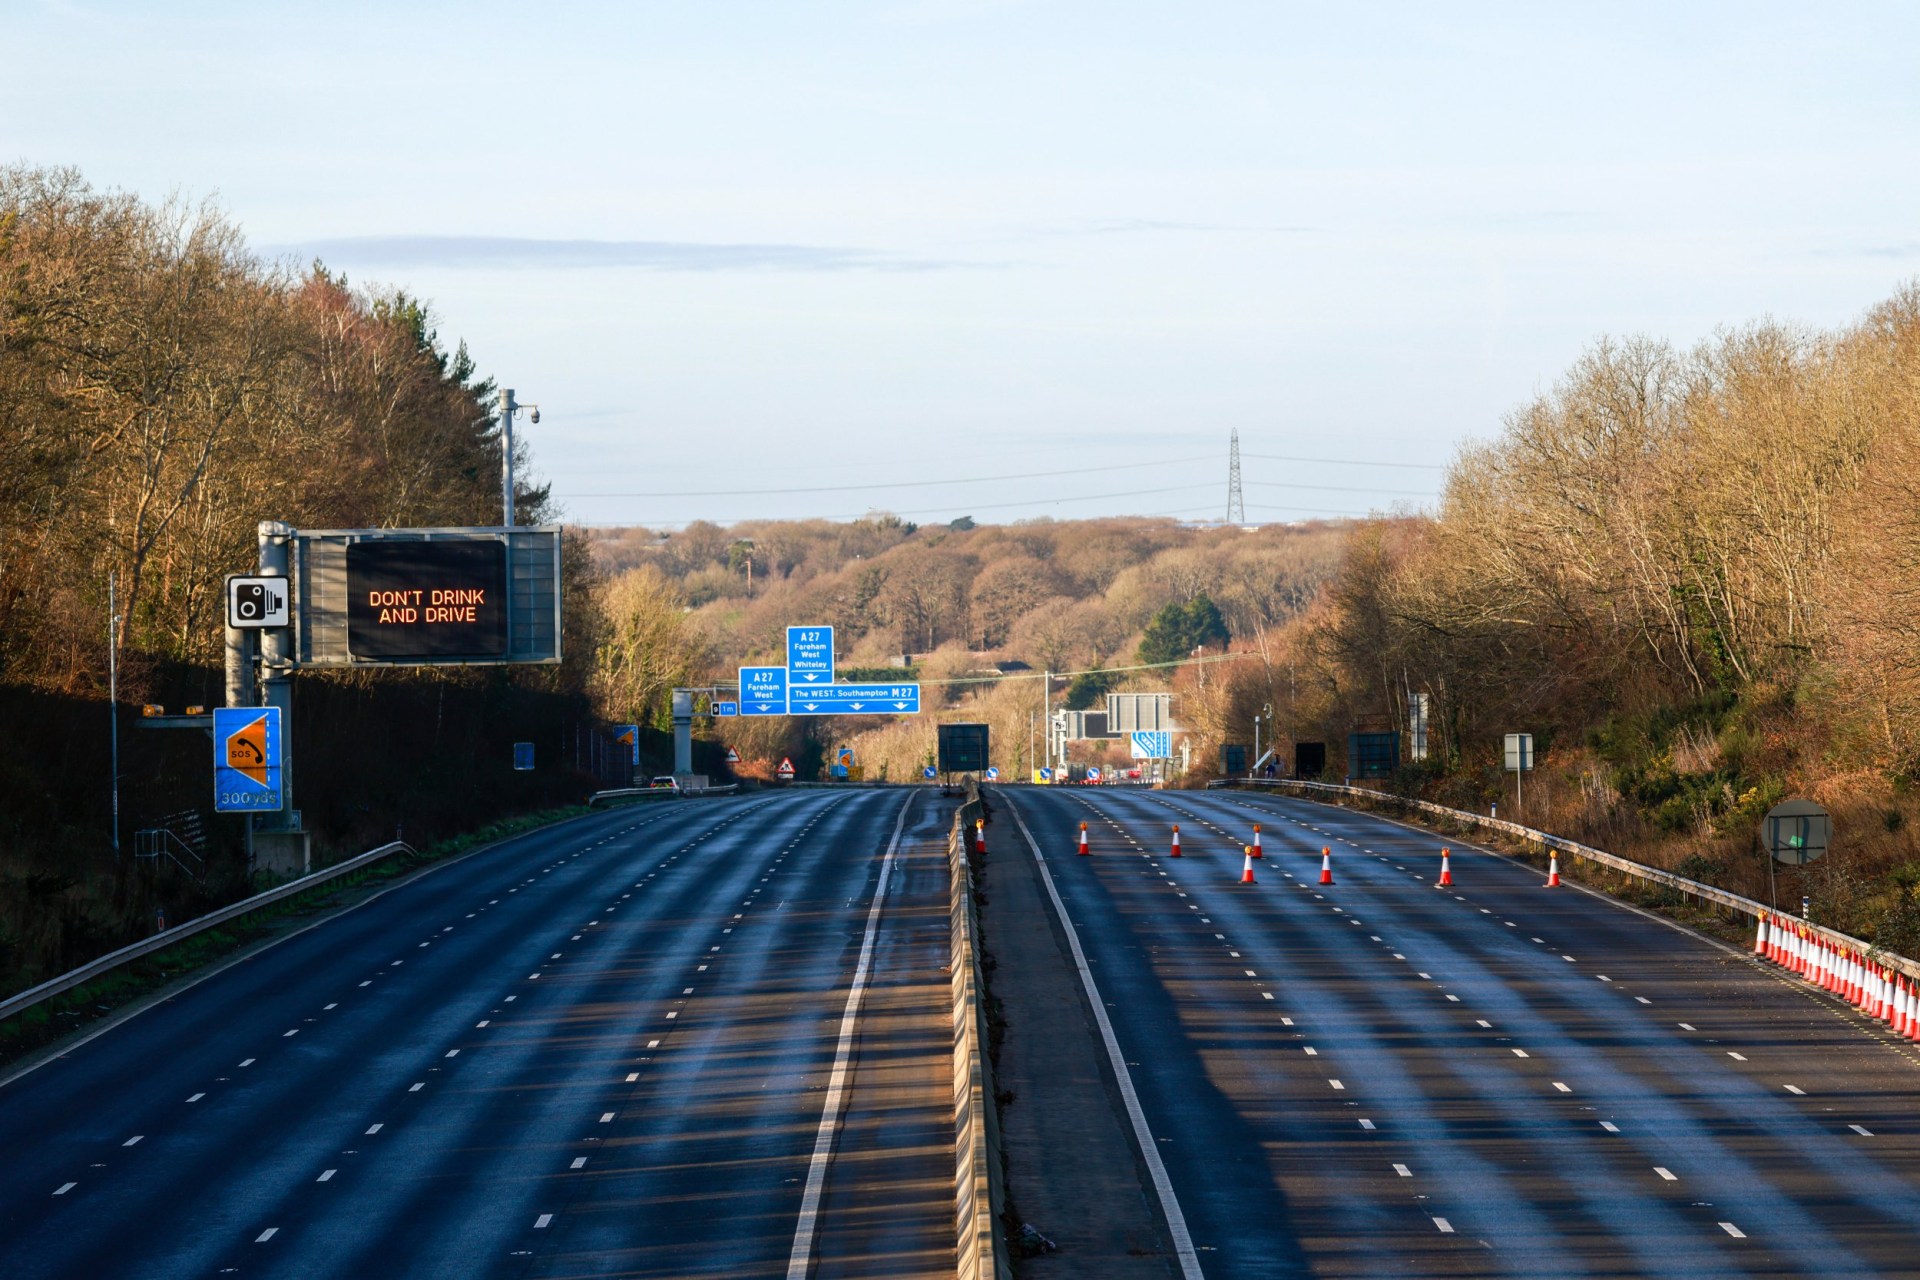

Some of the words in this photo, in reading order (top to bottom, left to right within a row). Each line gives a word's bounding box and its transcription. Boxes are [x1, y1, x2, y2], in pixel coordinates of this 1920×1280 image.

[370, 591, 423, 606] DON'T
[432, 589, 484, 605] DRINK
[379, 608, 417, 623] AND
[425, 607, 476, 623] DRIVE
[794, 661, 827, 669] Whiteley
[747, 683, 780, 691] Fareham
[754, 691, 773, 699] West
[795, 690, 809, 698] The
[838, 689, 888, 698] Southampton
